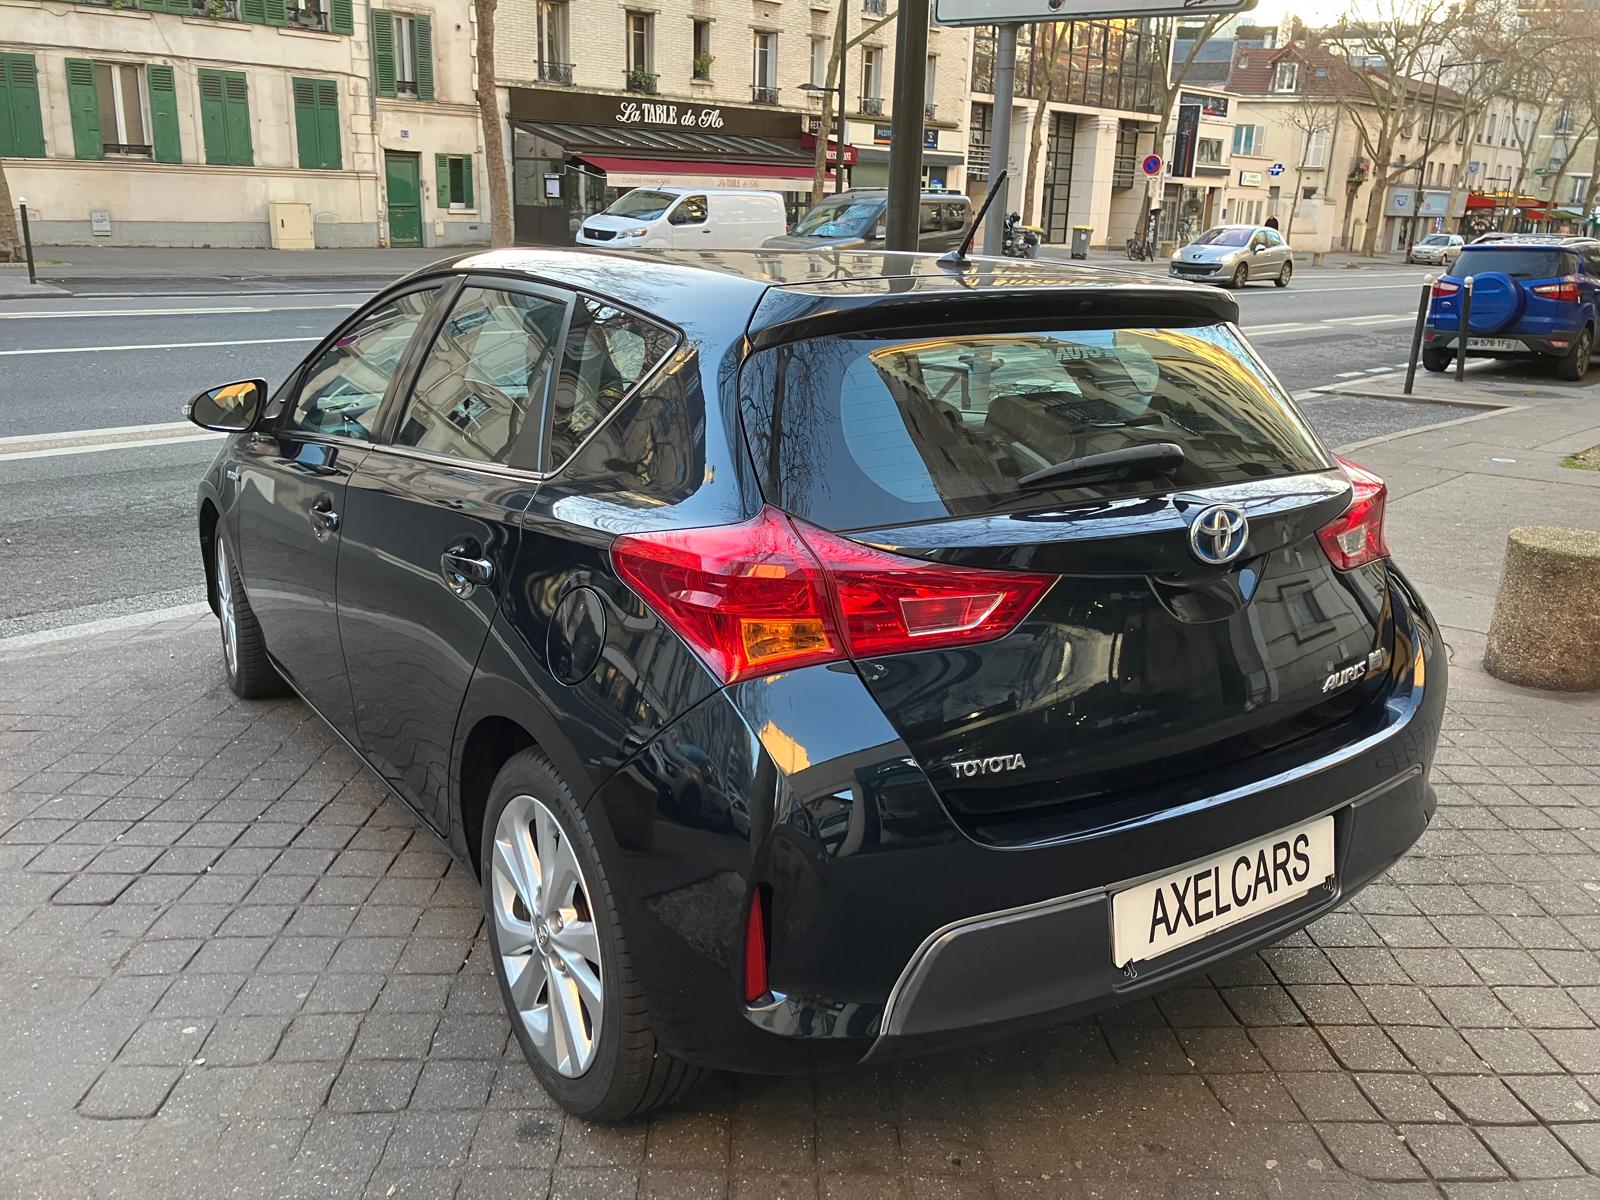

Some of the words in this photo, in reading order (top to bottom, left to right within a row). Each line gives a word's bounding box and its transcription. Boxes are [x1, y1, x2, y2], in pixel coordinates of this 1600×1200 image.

[616, 102, 641, 123] La
[642, 103, 677, 124] TABLE
[681, 109, 696, 126] de
[698, 109, 724, 128] Flo
[1321, 660, 1367, 693] AURIS
[950, 753, 1026, 779] TOYOTA
[1148, 833, 1311, 944] AXELCARS
